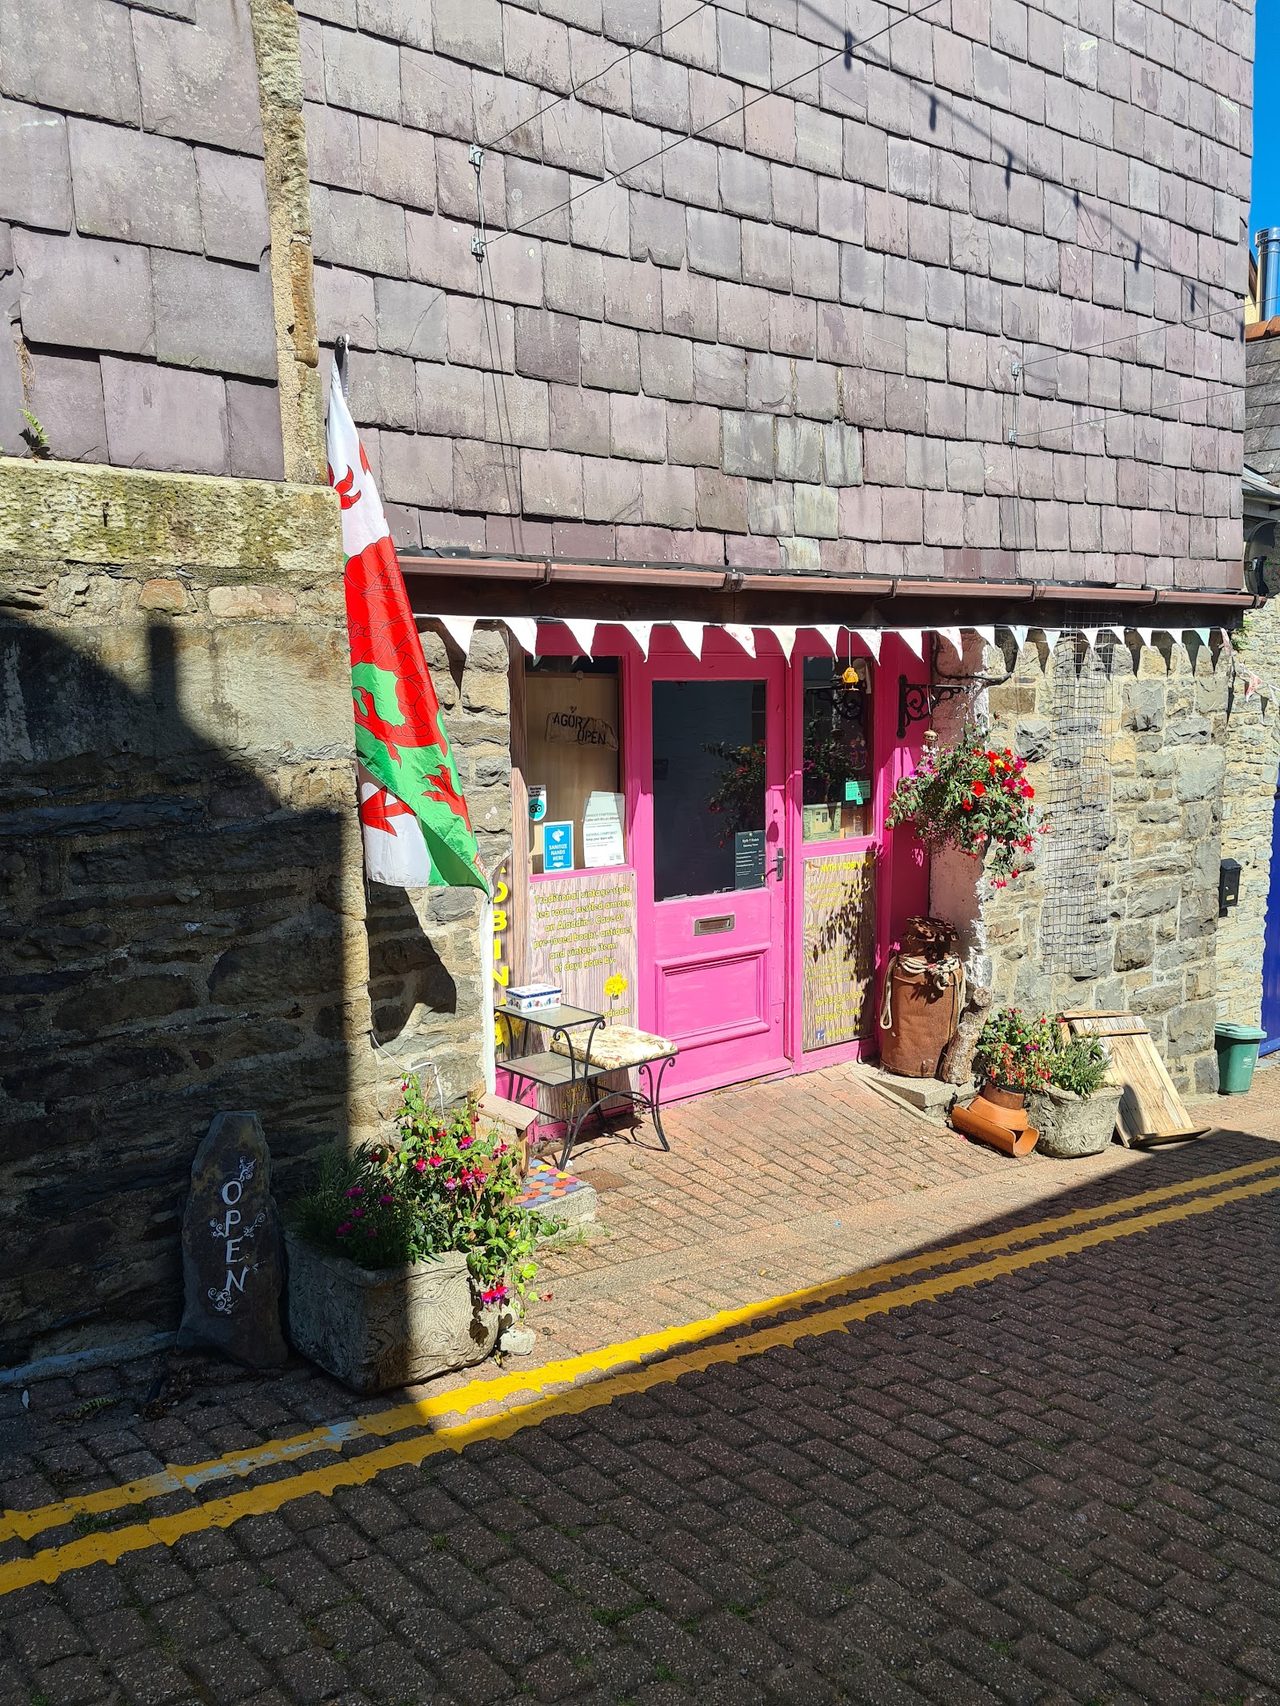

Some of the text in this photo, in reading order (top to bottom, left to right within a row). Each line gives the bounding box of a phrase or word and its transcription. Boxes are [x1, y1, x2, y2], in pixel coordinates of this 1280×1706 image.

[577, 730, 606, 745] OPEN
[544, 924, 555, 932] an
[548, 949, 565, 960] and
[221, 1180, 250, 1293] OPEN
